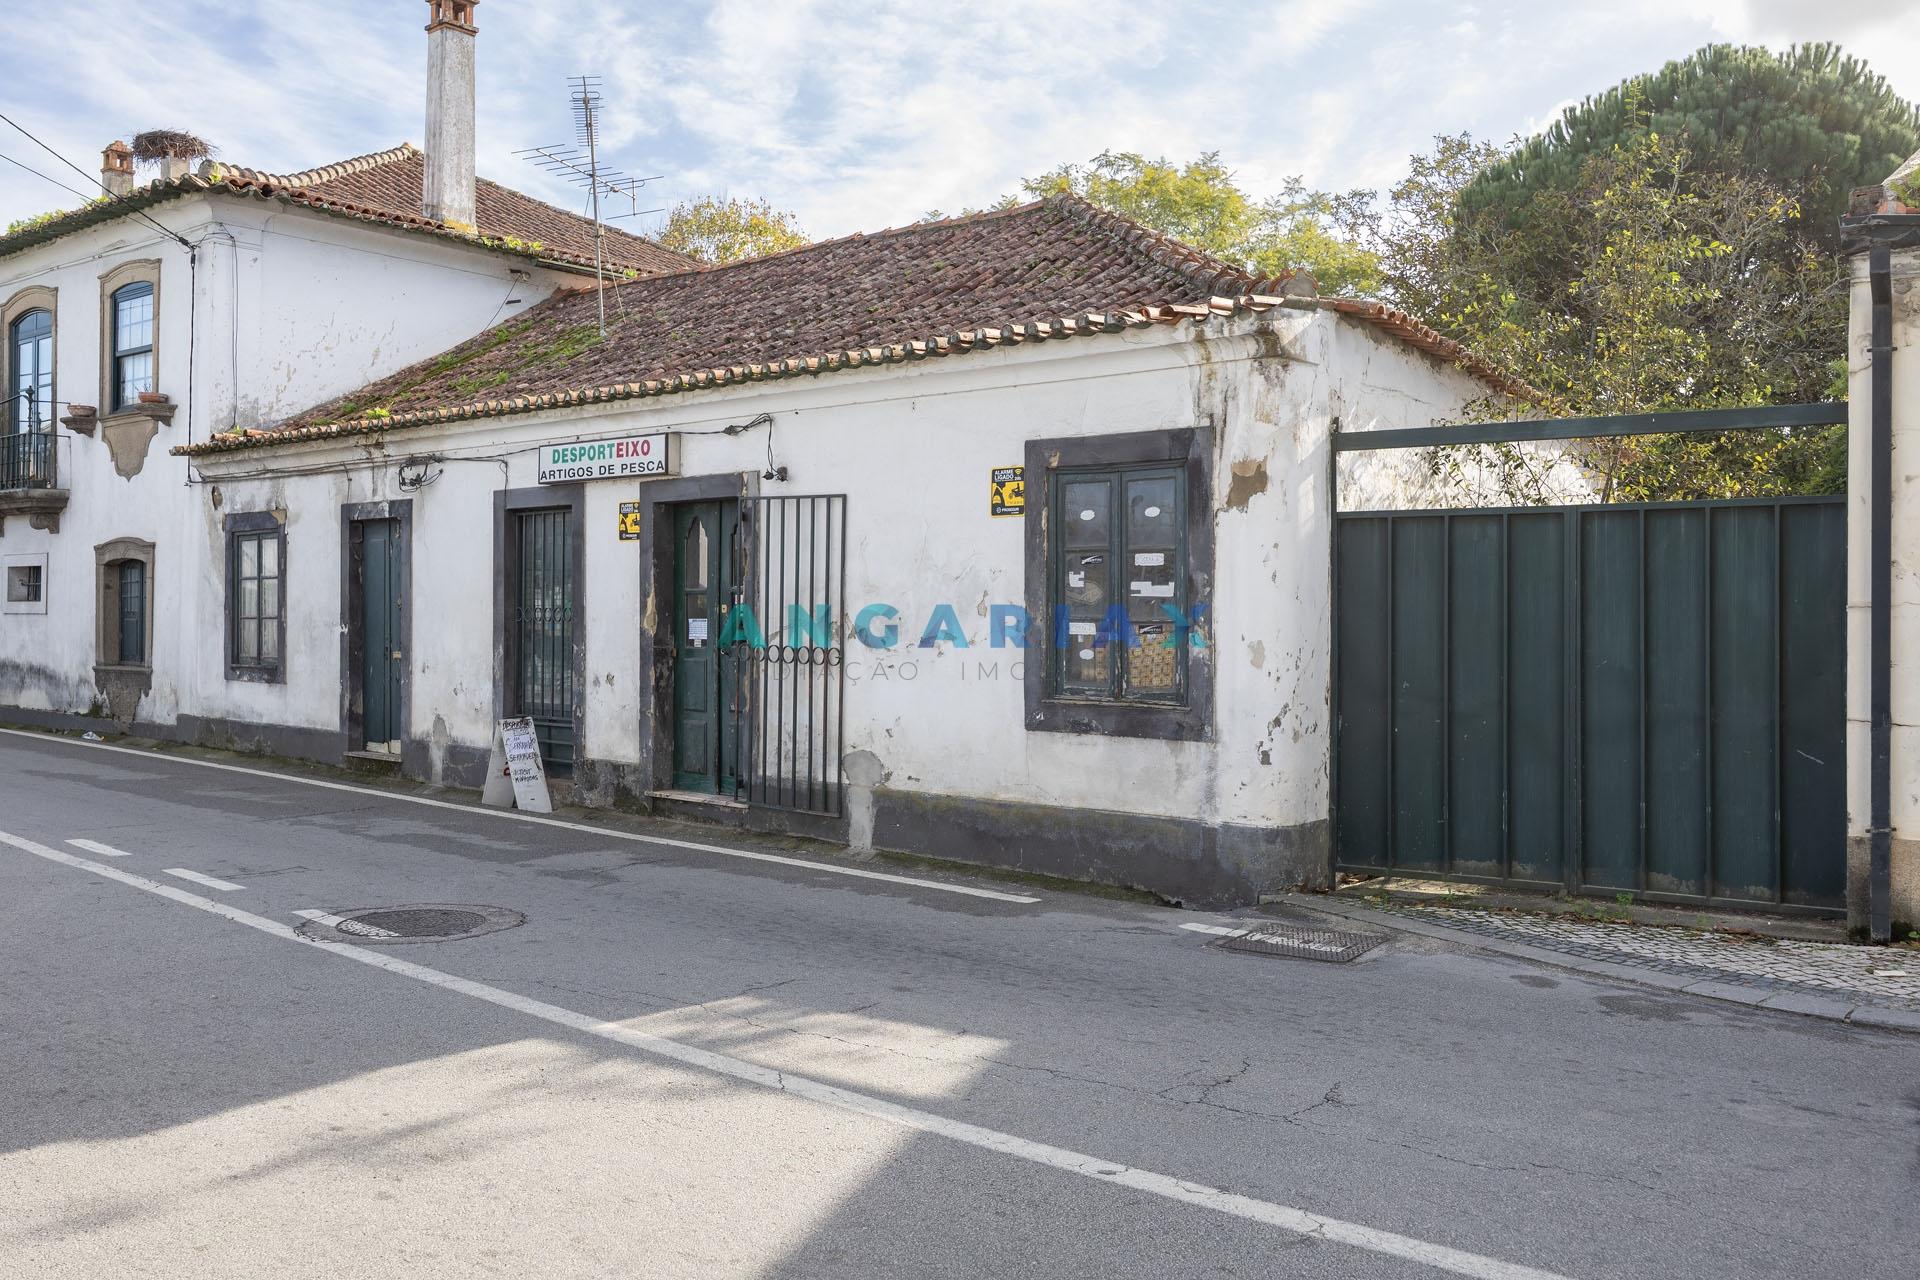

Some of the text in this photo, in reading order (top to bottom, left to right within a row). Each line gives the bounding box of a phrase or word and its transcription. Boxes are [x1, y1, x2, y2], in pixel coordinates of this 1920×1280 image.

[552, 439, 651, 464] DESPORTEIXO
[540, 460, 665, 481] ARTIGOS DE PESCA
